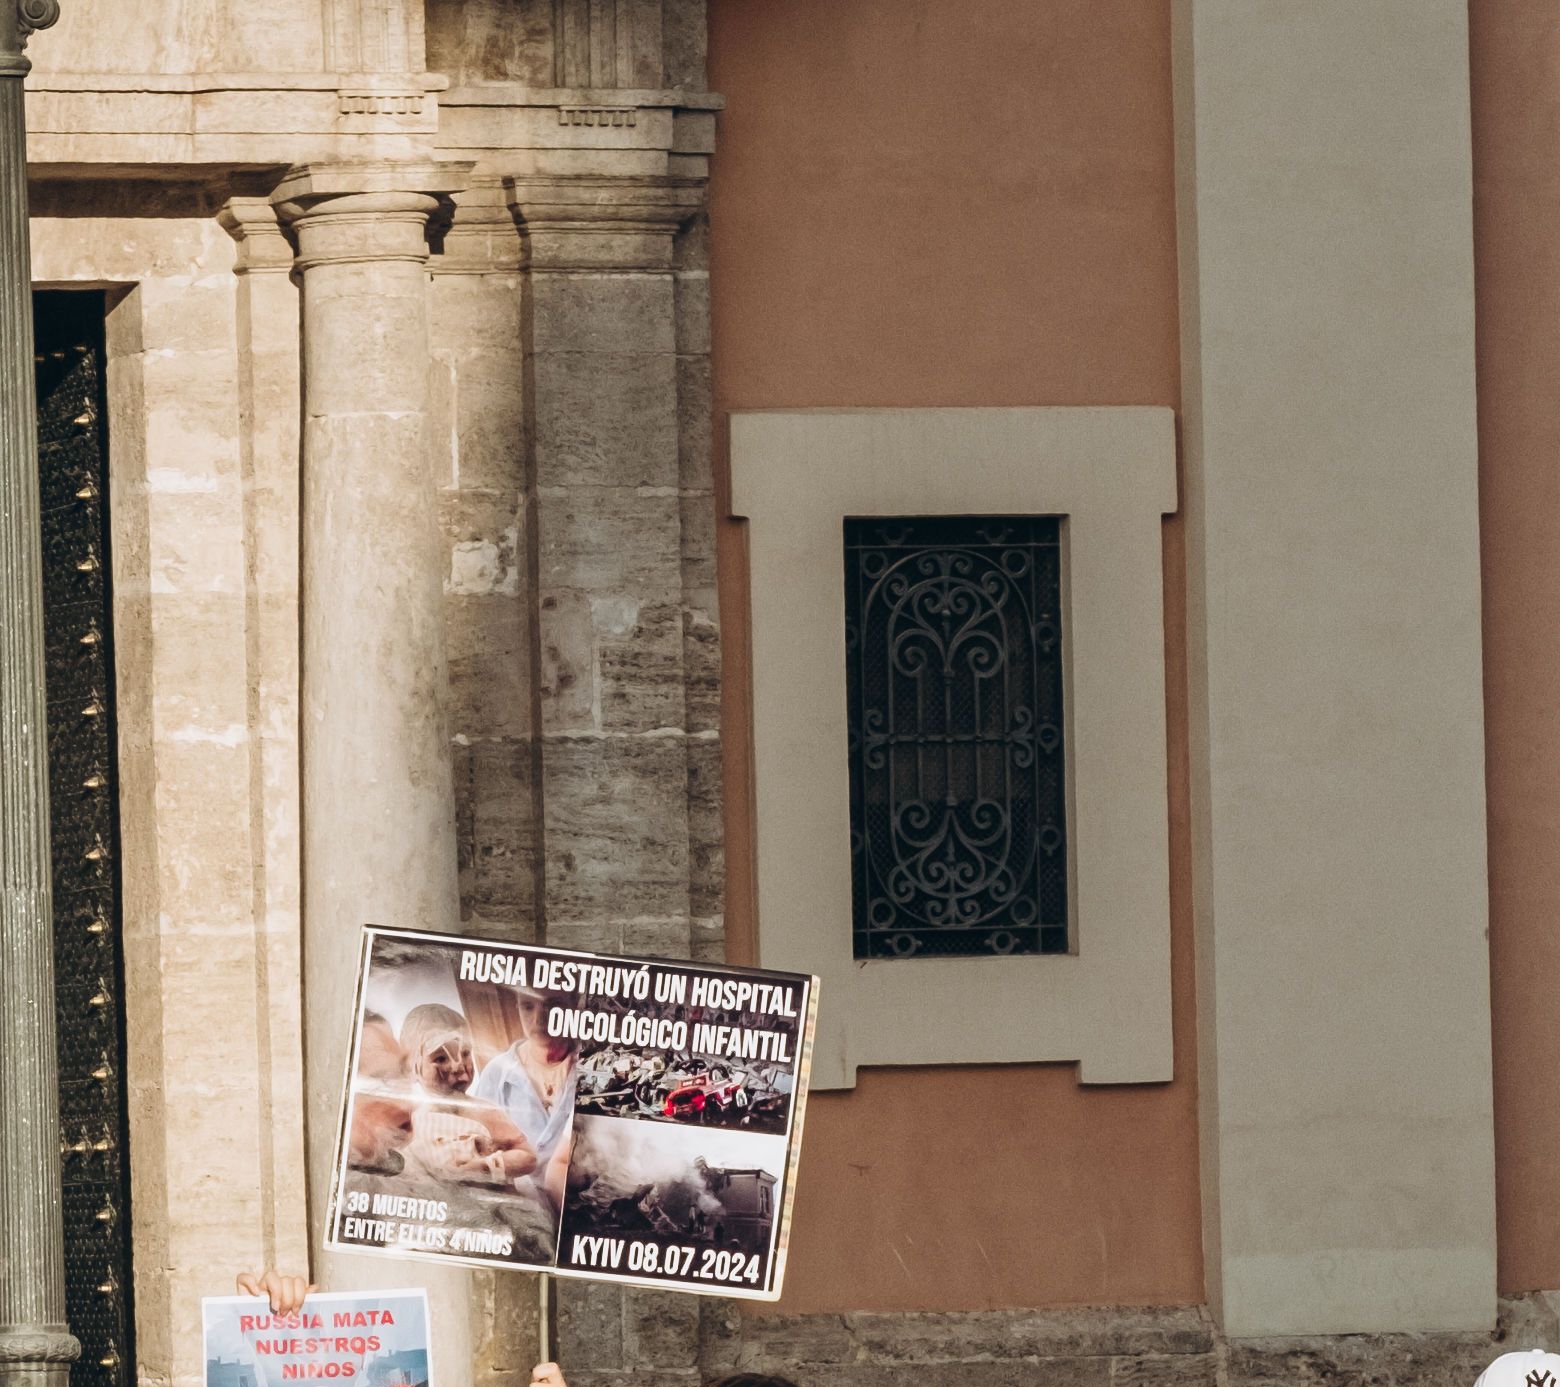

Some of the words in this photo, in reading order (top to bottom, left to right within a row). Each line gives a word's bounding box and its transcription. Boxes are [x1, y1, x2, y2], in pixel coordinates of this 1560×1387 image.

[460, 951, 528, 987] RUSIA
[533, 957, 651, 1000] DESTRUYÓ
[653, 973, 685, 1004] UN
[691, 980, 798, 1017] HOSPITAL
[547, 1008, 688, 1051] ONCOLÓGICO
[692, 1022, 792, 1063] INFANTIL
[347, 1191, 370, 1213] 38
[372, 1193, 448, 1222] MUERTOS
[344, 1217, 398, 1243] ENTRE
[398, 1223, 449, 1249] ELLOS
[449, 1227, 463, 1250] 4
[571, 1235, 622, 1269] KYIV
[628, 1241, 760, 1284] 08.07.2024
[240, 1313, 324, 1332] RUSSIA
[333, 1310, 395, 1328] MATA
[255, 1336, 381, 1355] NUESTROS
